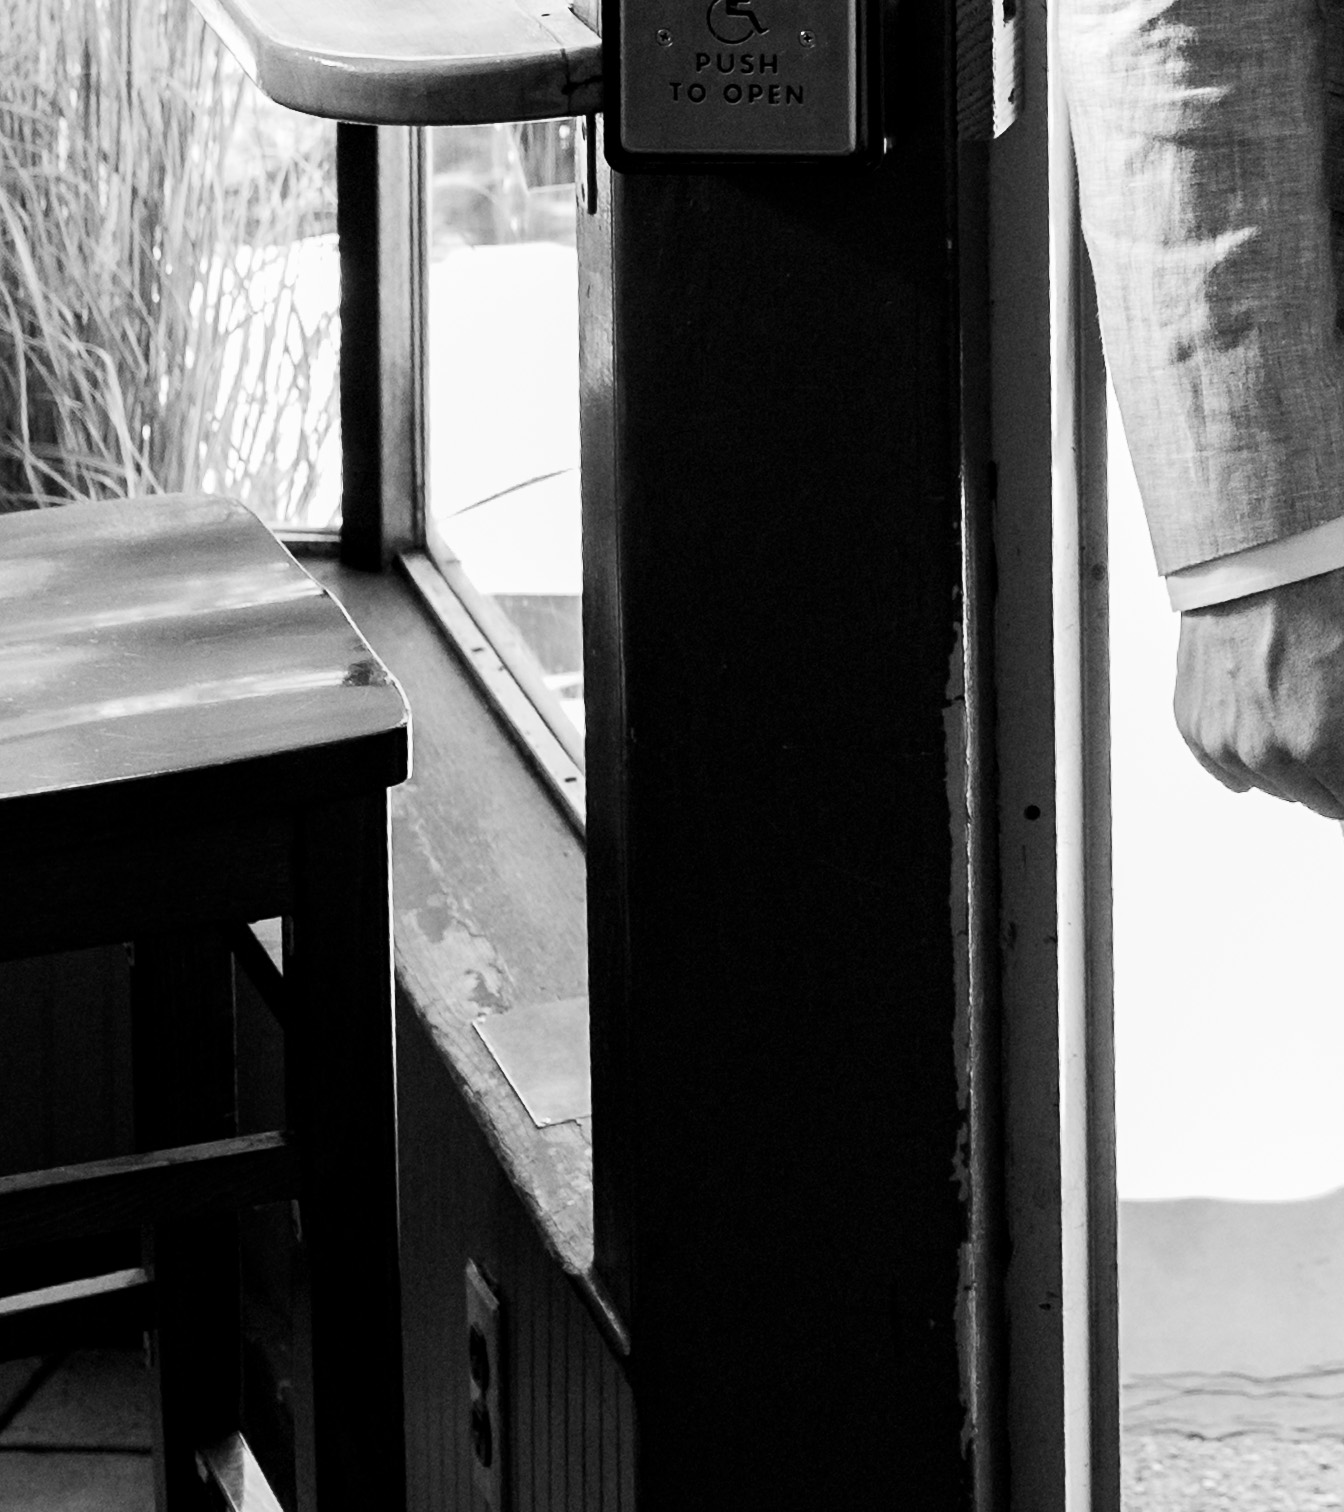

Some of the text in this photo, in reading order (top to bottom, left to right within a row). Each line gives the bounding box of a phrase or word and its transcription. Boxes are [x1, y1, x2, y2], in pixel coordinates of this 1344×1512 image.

[695, 52, 778, 74] PUSH
[669, 82, 804, 105] TO OPEN
